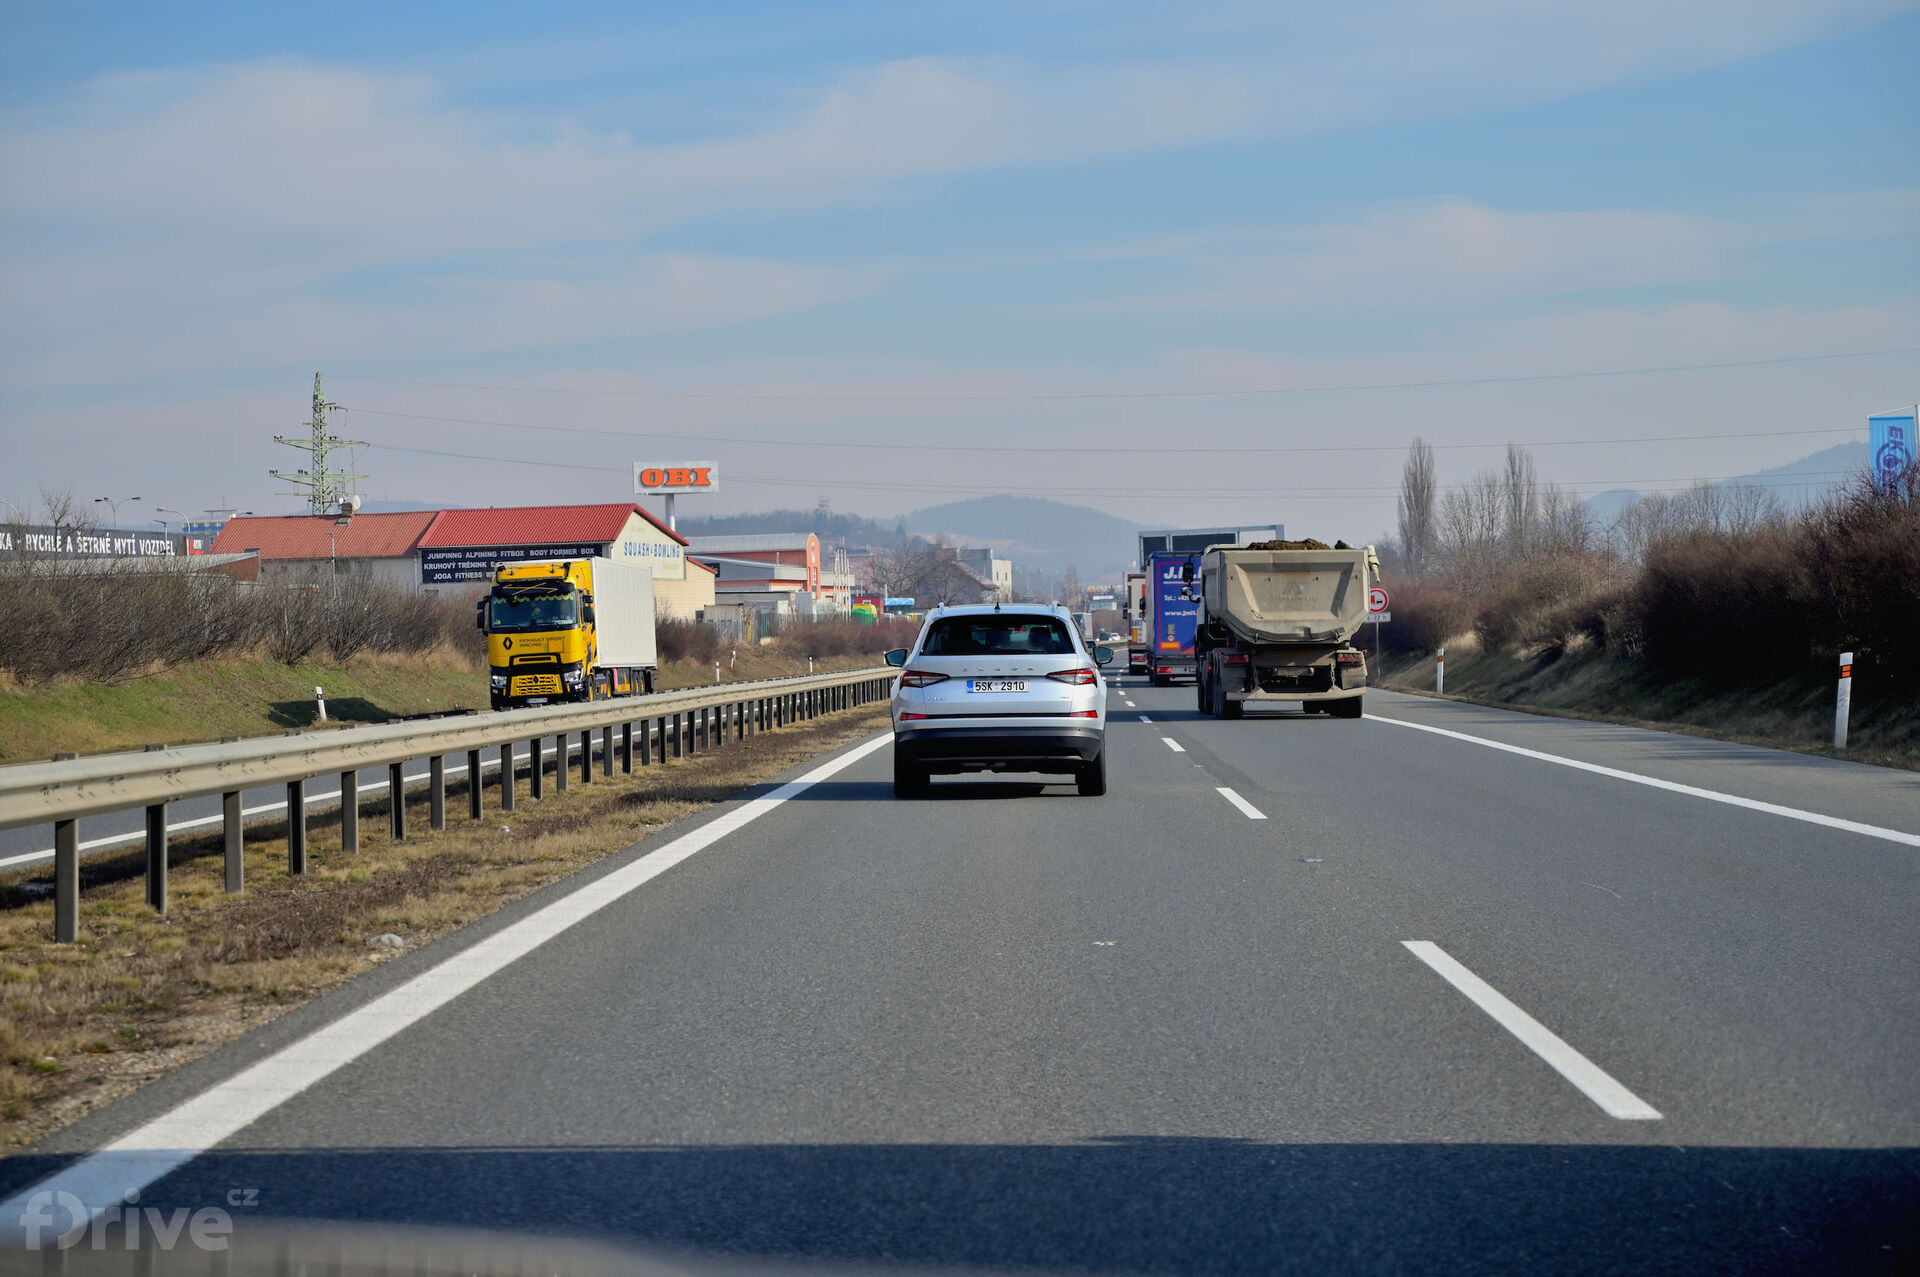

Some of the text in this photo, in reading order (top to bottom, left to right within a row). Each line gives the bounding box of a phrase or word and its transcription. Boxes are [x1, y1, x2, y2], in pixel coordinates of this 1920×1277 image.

[640, 468, 711, 487] OBI
[25, 530, 62, 552] RYCHLÉ
[66, 536, 73, 552] A
[76, 531, 111, 553] ŠETRNÉ
[114, 533, 136, 555] MYTÍ
[139, 539, 175, 555] VOZIDEL
[550, 548, 577, 556] FORMER
[624, 541, 680, 558] SQUASH BOWLING
[458, 561, 487, 569] TRÉNINK
[455, 571, 482, 579] FITNESS
[975, 681, 1025, 691] 5SK 2910
